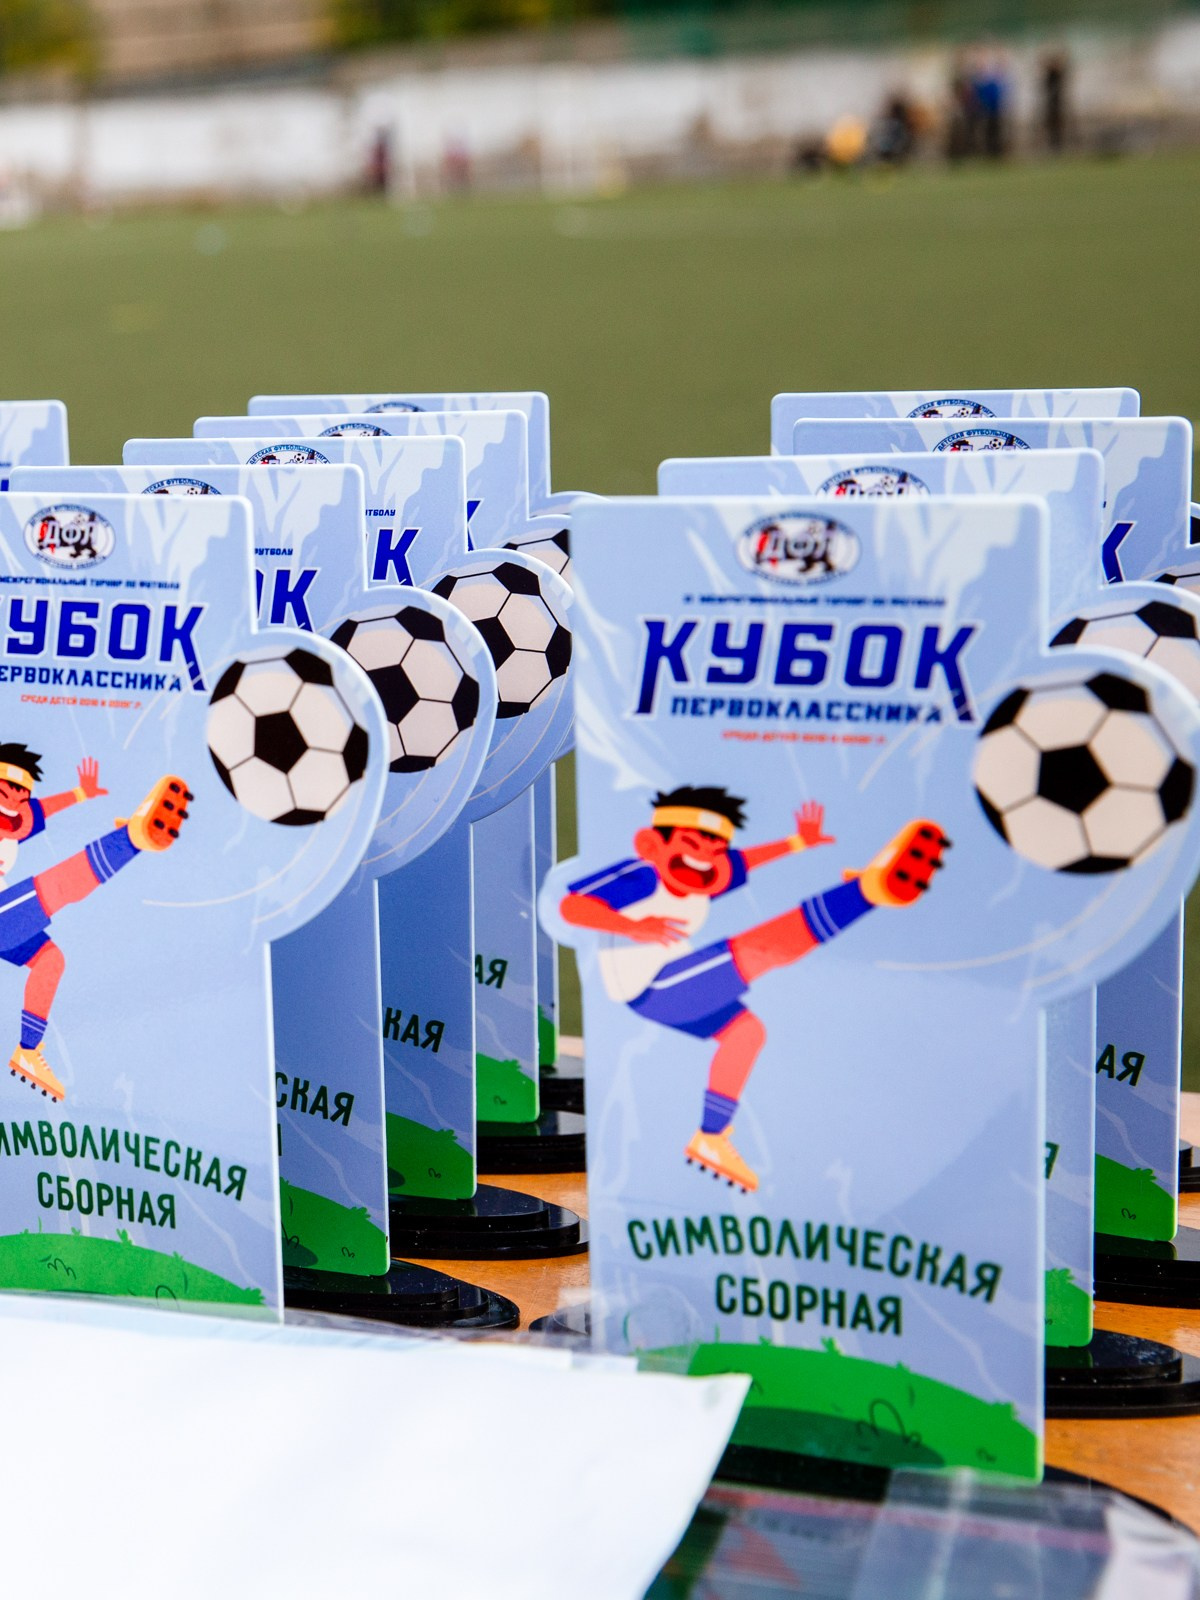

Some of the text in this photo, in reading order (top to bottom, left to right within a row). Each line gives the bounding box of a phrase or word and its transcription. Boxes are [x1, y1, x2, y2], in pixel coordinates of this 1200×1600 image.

[43, 521, 98, 549] ДФЛ
[365, 509, 396, 517] ТБОЛУ
[635, 620, 976, 722] КУБОК
[671, 696, 942, 723] ПЕРВОКЛАССНИКА
[36, 1171, 177, 1229] СБОРНАЯ
[626, 1214, 1003, 1304] СИМВОЛИЧЕСКАЯ
[715, 1273, 903, 1337] СБОРНАЯ
